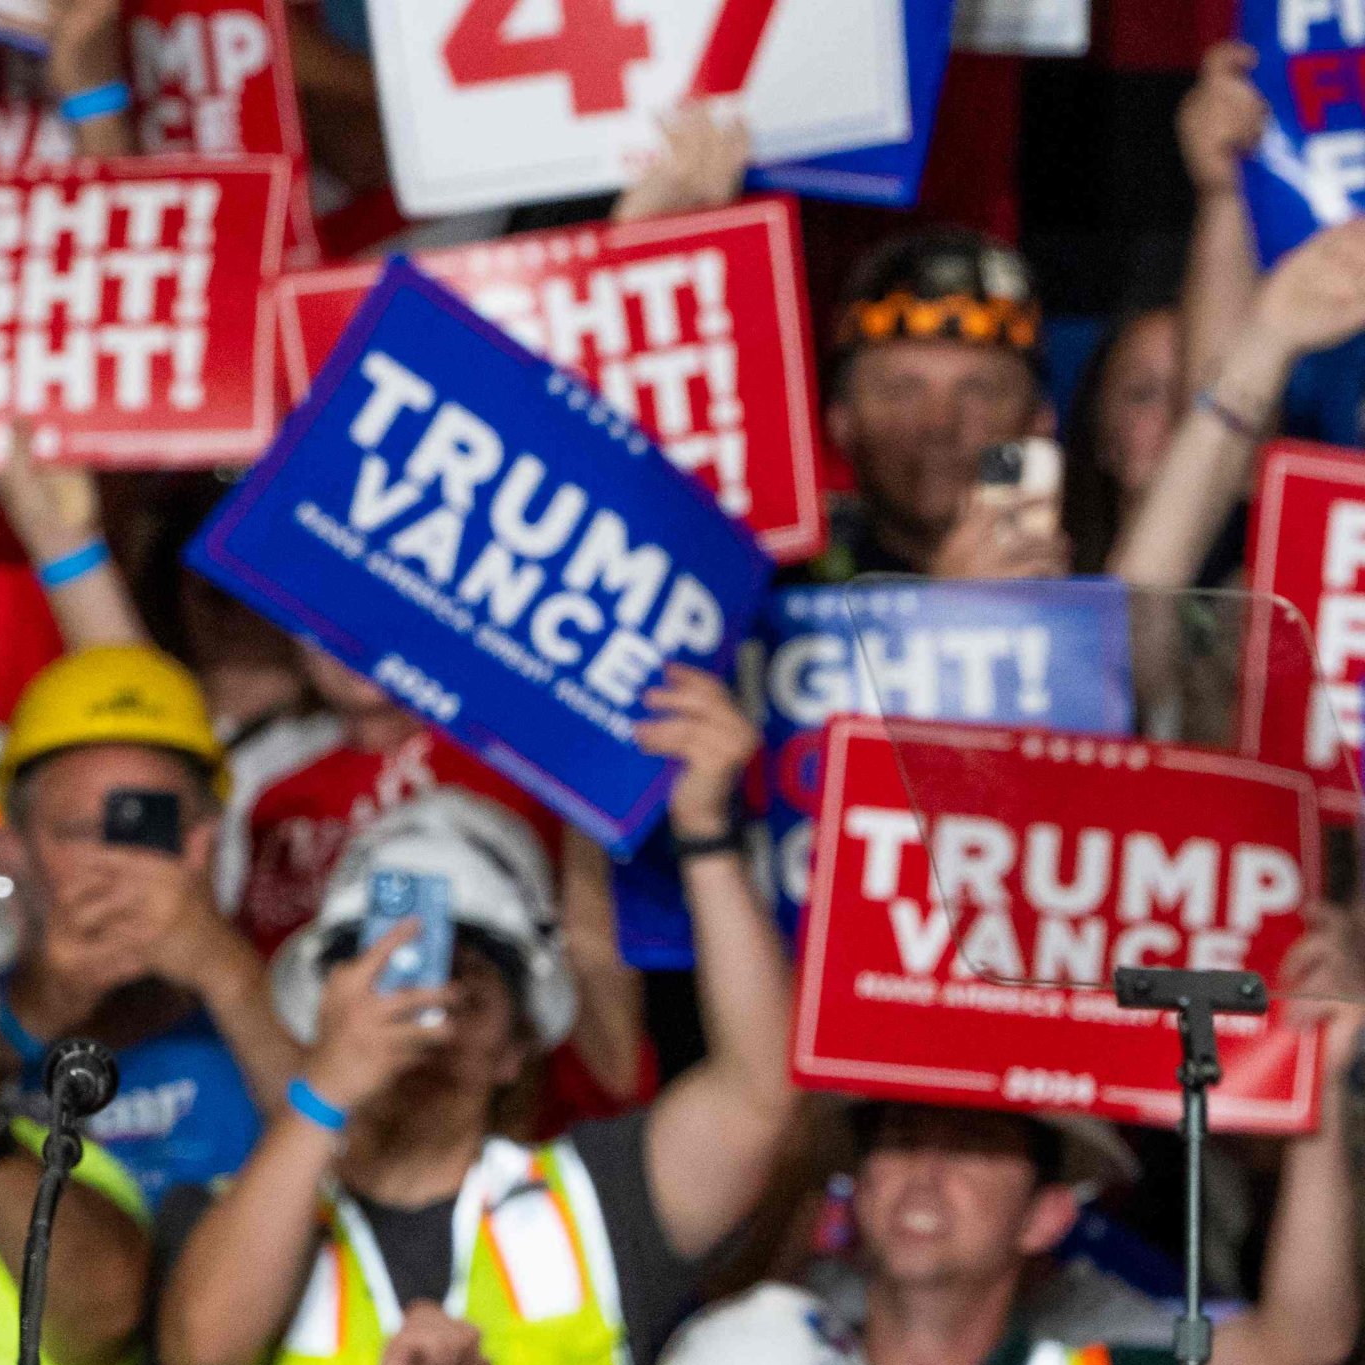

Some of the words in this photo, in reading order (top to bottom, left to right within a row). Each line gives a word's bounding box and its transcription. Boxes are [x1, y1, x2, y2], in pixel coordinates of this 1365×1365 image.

[348, 349, 725, 657] TRUMP
[348, 454, 665, 702] VANCE
[736, 626, 1053, 724] IGHT!
[846, 806, 1303, 932] TRUMP
[888, 899, 1257, 987] VANCE
